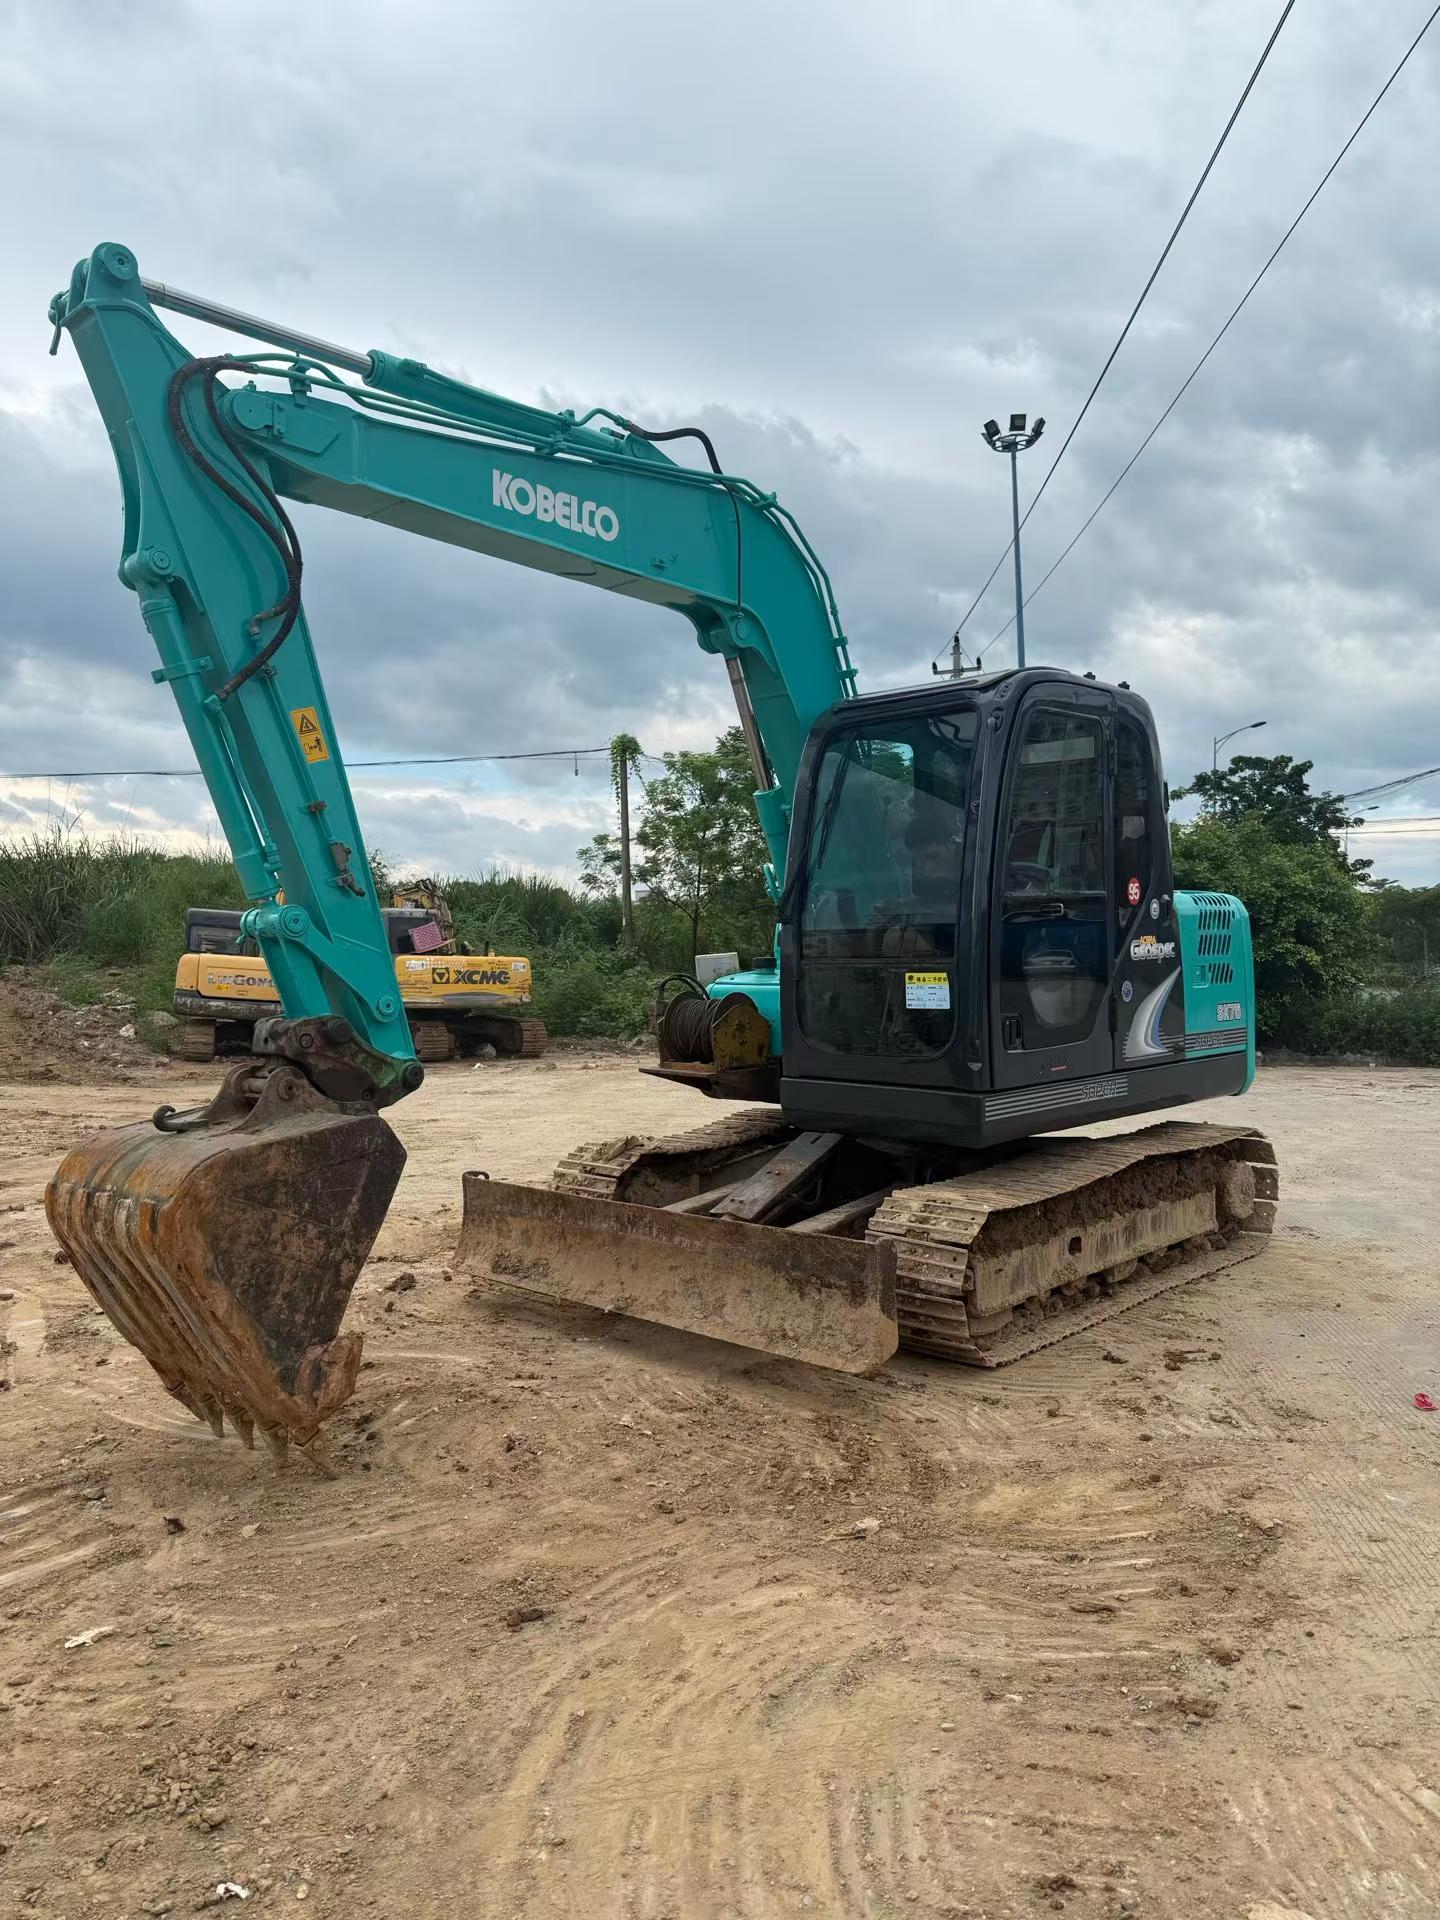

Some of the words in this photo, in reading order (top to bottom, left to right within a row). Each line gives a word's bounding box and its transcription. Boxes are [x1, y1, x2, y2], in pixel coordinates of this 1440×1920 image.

[492, 468, 620, 542] KOBELCO
[1128, 882, 1140, 900] 95
[450, 969, 511, 985] XCMG
